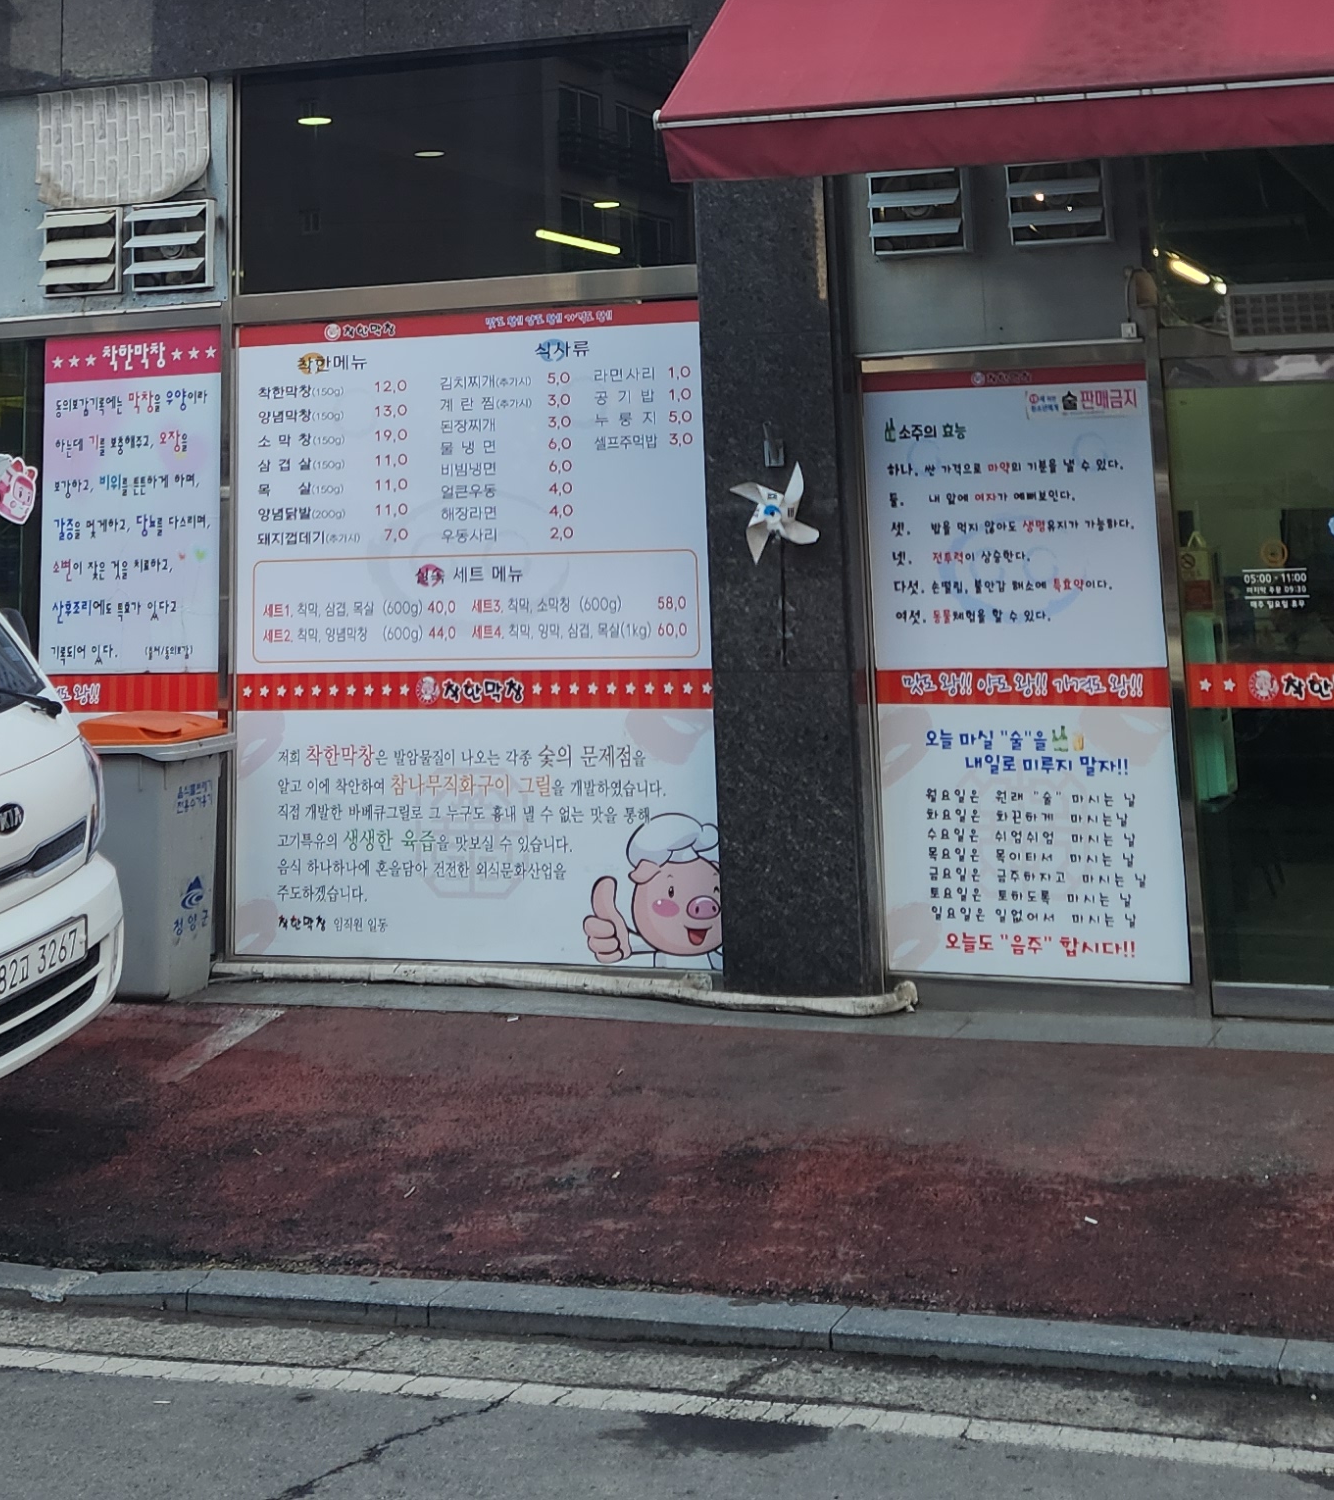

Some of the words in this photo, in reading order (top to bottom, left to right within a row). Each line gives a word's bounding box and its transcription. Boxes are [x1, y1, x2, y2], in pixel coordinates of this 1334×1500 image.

[343, 321, 396, 340] 착한막창
[102, 342, 166, 371] 착한막창
[534, 340, 590, 359] 식사류
[297, 354, 367, 373] 착한메뉴
[547, 372, 571, 388] 5,0
[593, 367, 656, 383] 라면사리
[668, 366, 691, 381] 1,0
[374, 379, 407, 395] 12,0
[668, 388, 692, 404] 1,0
[128, 391, 161, 414] 막창을
[166, 388, 208, 411] 우양이라
[547, 393, 571, 410] 3,0
[1080, 388, 1137, 410] 판매금지
[374, 404, 407, 419] 13,0
[668, 410, 693, 426] 5,0
[440, 418, 496, 433] 된장찌개
[547, 415, 572, 432] 3,0
[899, 424, 937, 440] 소주의
[942, 423, 966, 438] 효능
[55, 438, 84, 458] 하는데
[89, 435, 105, 456] 기를
[159, 430, 188, 452] 오장을
[374, 428, 408, 444] 19,0
[548, 437, 572, 454] 6,0
[594, 434, 658, 451] 셀프주먹밥
[669, 432, 693, 449] 3,0
[375, 453, 408, 468] 11,0
[441, 461, 496, 477] 비빔냉면
[548, 459, 572, 476] 6,0
[54, 479, 94, 499] 보강하고,
[99, 474, 128, 496] 비위를
[133, 474, 169, 495] 튼튼하게
[174, 473, 200, 487] 하며,
[375, 477, 408, 493] 11,0
[441, 484, 497, 500] 얼큰우동
[549, 481, 573, 498] 4,0
[375, 502, 408, 518] 11,0
[441, 505, 497, 522] 해장라면
[549, 503, 573, 520] 4,0
[53, 518, 81, 541] 갈증을
[136, 514, 163, 537] 당뇨를
[169, 514, 211, 529] 다스리며,
[384, 528, 409, 543] 7,0
[441, 528, 497, 544] 우동사리
[550, 526, 574, 542] 2,0
[53, 559, 83, 582] 소변이
[453, 566, 484, 584] 세트
[492, 565, 523, 583] 메뉴
[1244, 574, 1272, 584] 05:00
[1282, 572, 1307, 583] 11:00
[52, 600, 112, 624] 산후조리에도
[117, 600, 142, 622] 특효가
[147, 599, 177, 621] 있다고
[51, 645, 86, 666] 기록되어
[442, 677, 525, 703] 착한막창
[902, 673, 937, 695] 맛도
[939, 673, 972, 697] 왕!!
[977, 674, 1010, 695] 양도
[1015, 673, 1048, 697] 왕!!
[1052, 674, 1106, 695] 가격도
[1109, 674, 1144, 698] 왕!!
[925, 729, 954, 749] 오늘
[959, 730, 994, 750] 마실
[277, 749, 300, 766] 저희
[306, 744, 388, 767] 착한막창은
[394, 749, 455, 767] 발암물질이
[462, 750, 500, 766] 나오는
[506, 750, 532, 767] 각종
[538, 745, 572, 768] 숯의
[580, 745, 646, 768] 문제점을
[965, 755, 1017, 775] 내일로
[1023, 757, 1072, 772] 미루지
[1079, 756, 1129, 777] 말자!!
[277, 778, 302, 795] 알고
[307, 778, 330, 794] 이에
[336, 778, 385, 795] 착안하여
[391, 774, 509, 797] 참나무직화구이
[518, 774, 565, 797] 그릴을
[570, 779, 667, 798] 개발하였습니다.
[277, 832, 338, 850] 고기특유의
[343, 829, 393, 852] 생생한
[401, 829, 449, 852] 육즙을
[455, 835, 494, 852] 맛보실
[518, 836, 573, 853] 있습니다.
[173, 909, 209, 936] 청양군
[278, 915, 326, 931] 착한막창
[37, 928, 78, 975] 3267
[946, 933, 994, 955] 오늘도
[1000, 934, 1052, 956] "음주"
[1060, 936, 1136, 958] 합시다!!
